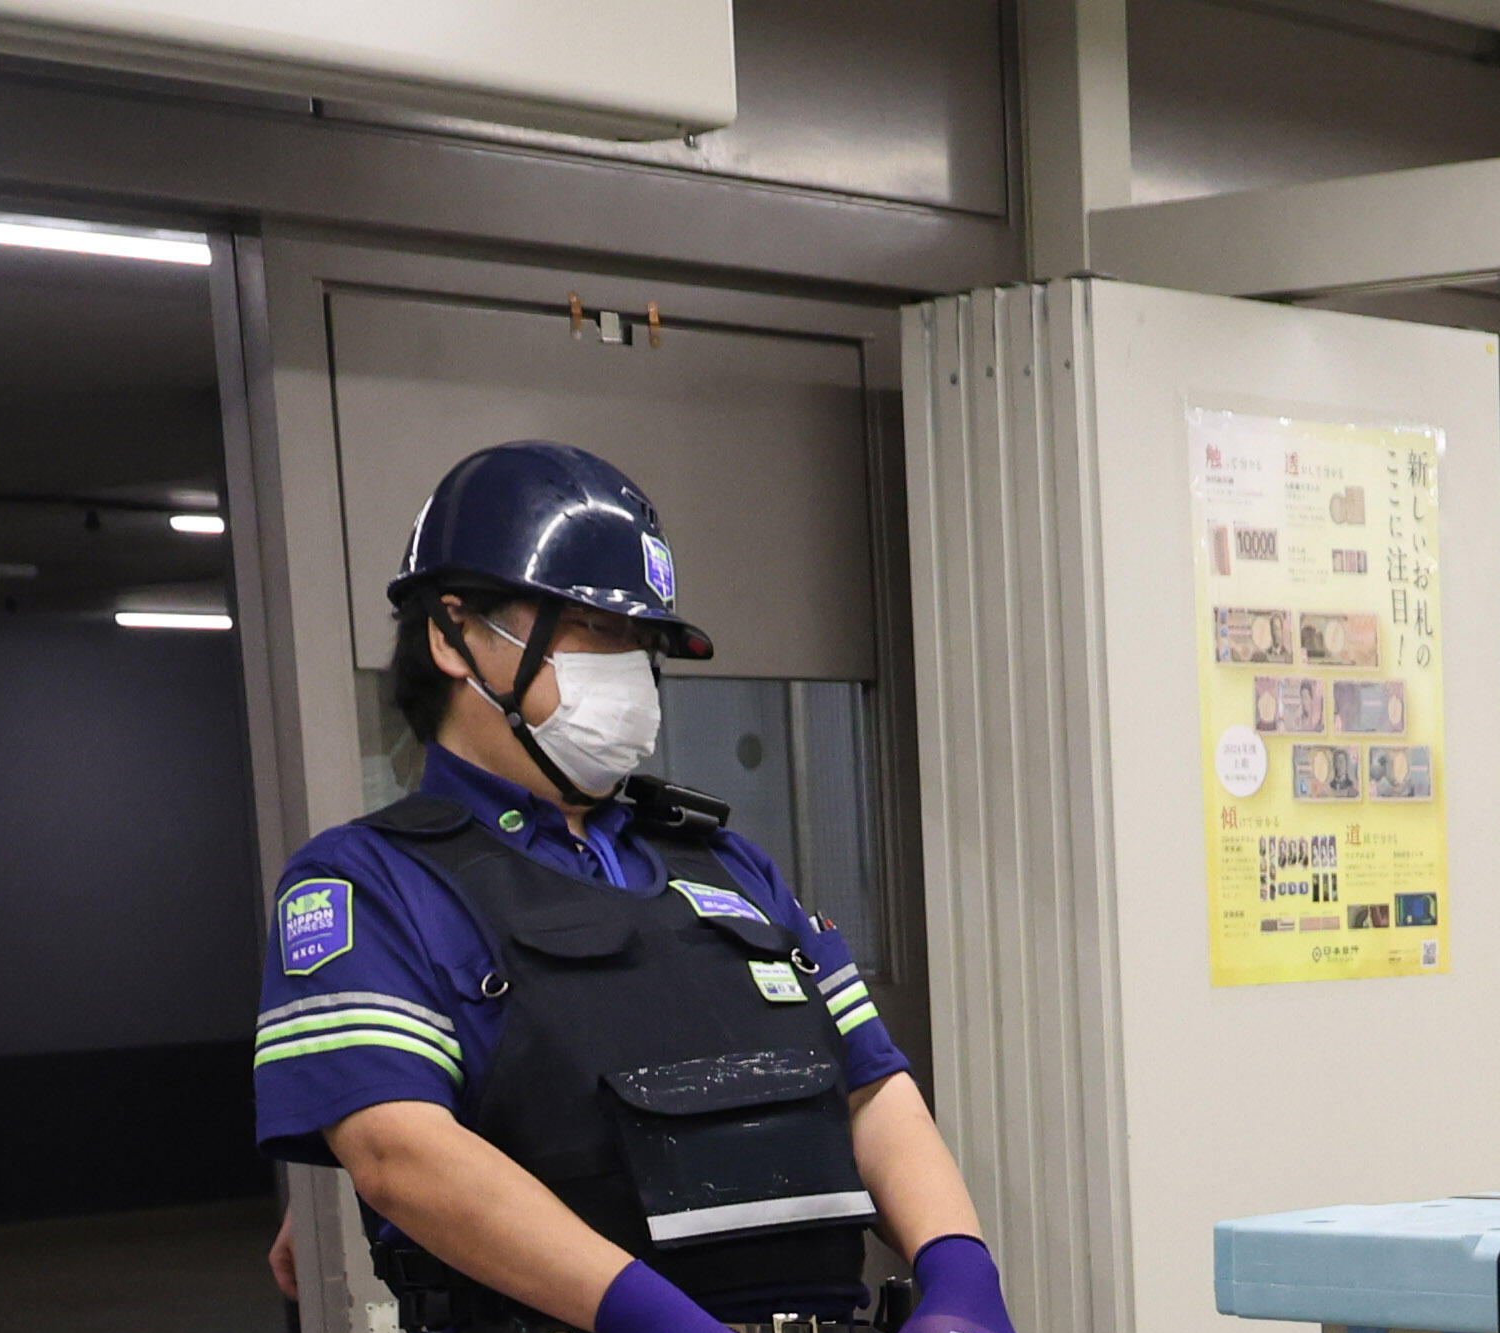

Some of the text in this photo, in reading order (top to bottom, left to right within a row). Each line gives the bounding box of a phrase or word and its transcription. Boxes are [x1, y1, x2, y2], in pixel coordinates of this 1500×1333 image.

[1407, 448, 1435, 668] 新しいお札の
[287, 888, 332, 920] NX
[287, 908, 334, 931] NIPPON
